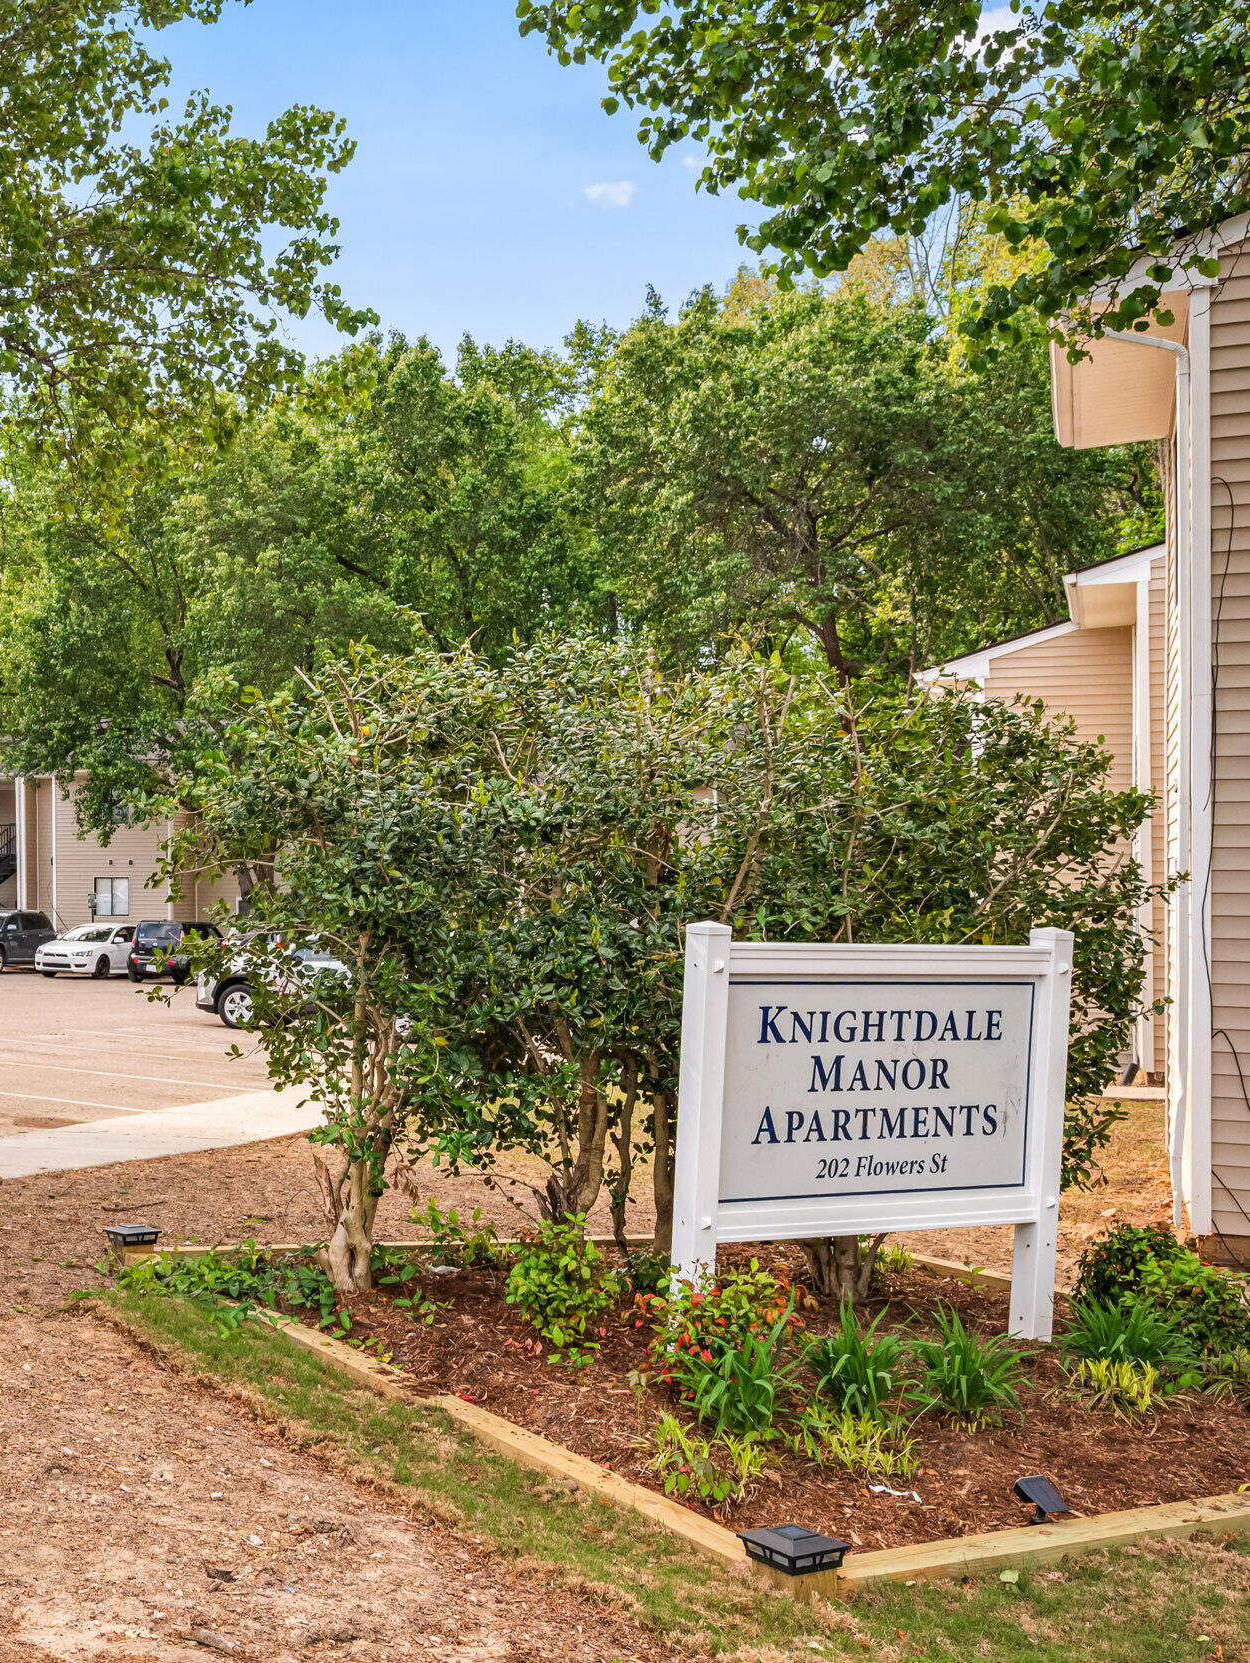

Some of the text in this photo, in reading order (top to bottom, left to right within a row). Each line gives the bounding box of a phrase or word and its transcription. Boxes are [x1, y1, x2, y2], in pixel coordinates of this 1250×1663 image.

[756, 1005, 1003, 1044] KNIGHTDALE
[807, 1055, 951, 1093] MANOR
[750, 1104, 998, 1145] APARTMENTS
[815, 1152, 949, 1179] 202 Flowers St
